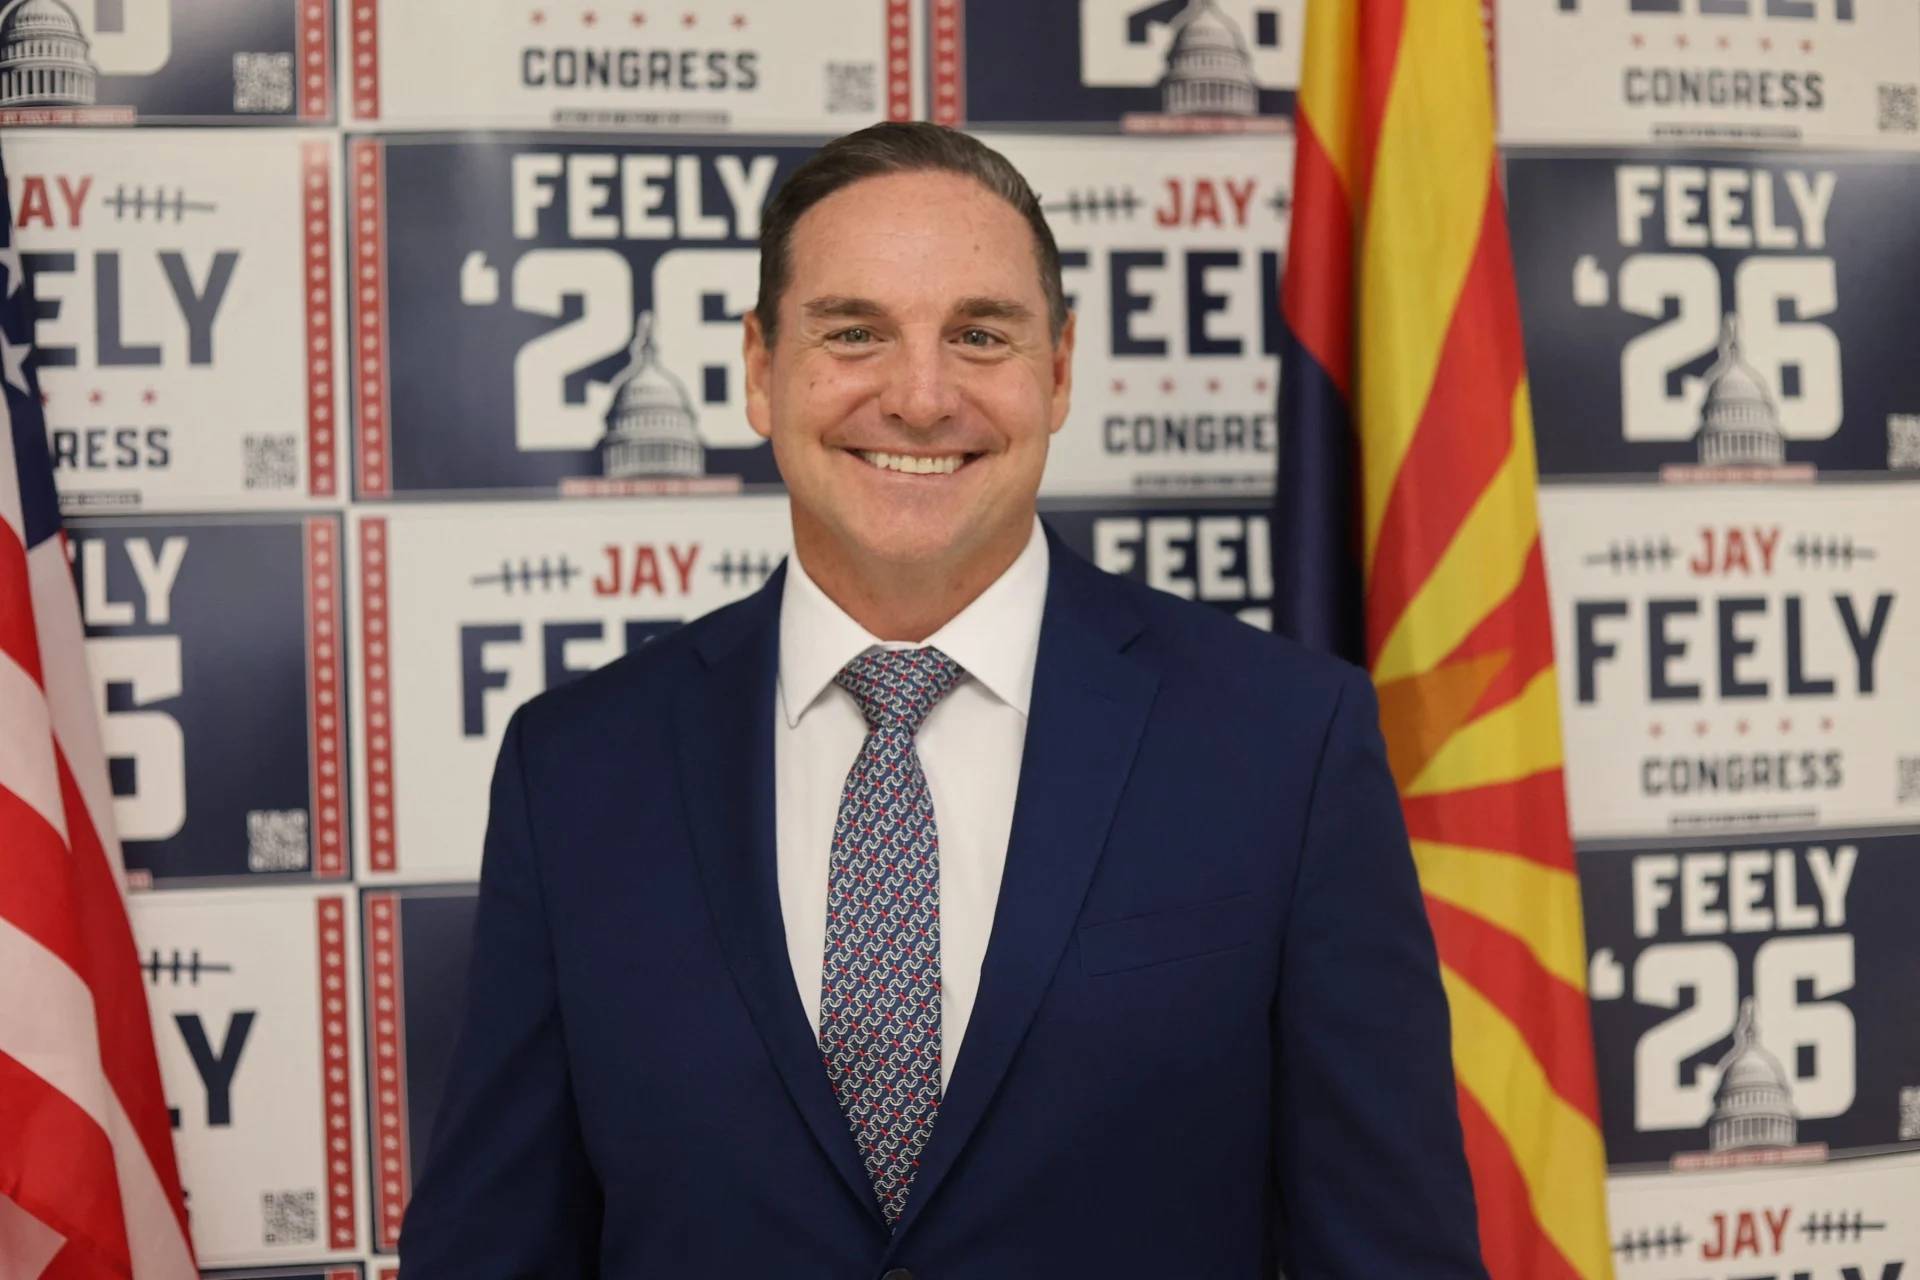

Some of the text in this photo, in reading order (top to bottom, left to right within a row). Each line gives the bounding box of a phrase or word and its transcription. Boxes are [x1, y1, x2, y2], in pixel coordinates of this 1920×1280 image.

[522, 48, 760, 91] CONGRESS
[1623, 67, 1826, 111] CONGRESS
[17, 175, 93, 229] AY
[511, 153, 778, 239] FEELY
[1155, 178, 1258, 228] JAY
[1614, 165, 1838, 249] FEELY
[593, 541, 701, 597] JAY
[1689, 526, 1781, 578] JAY
[1573, 592, 1897, 706] FEELY
[1641, 752, 1844, 798] CONGRESS
[1632, 845, 1859, 939] FEELY
[1702, 1207, 1792, 1262] JAY
